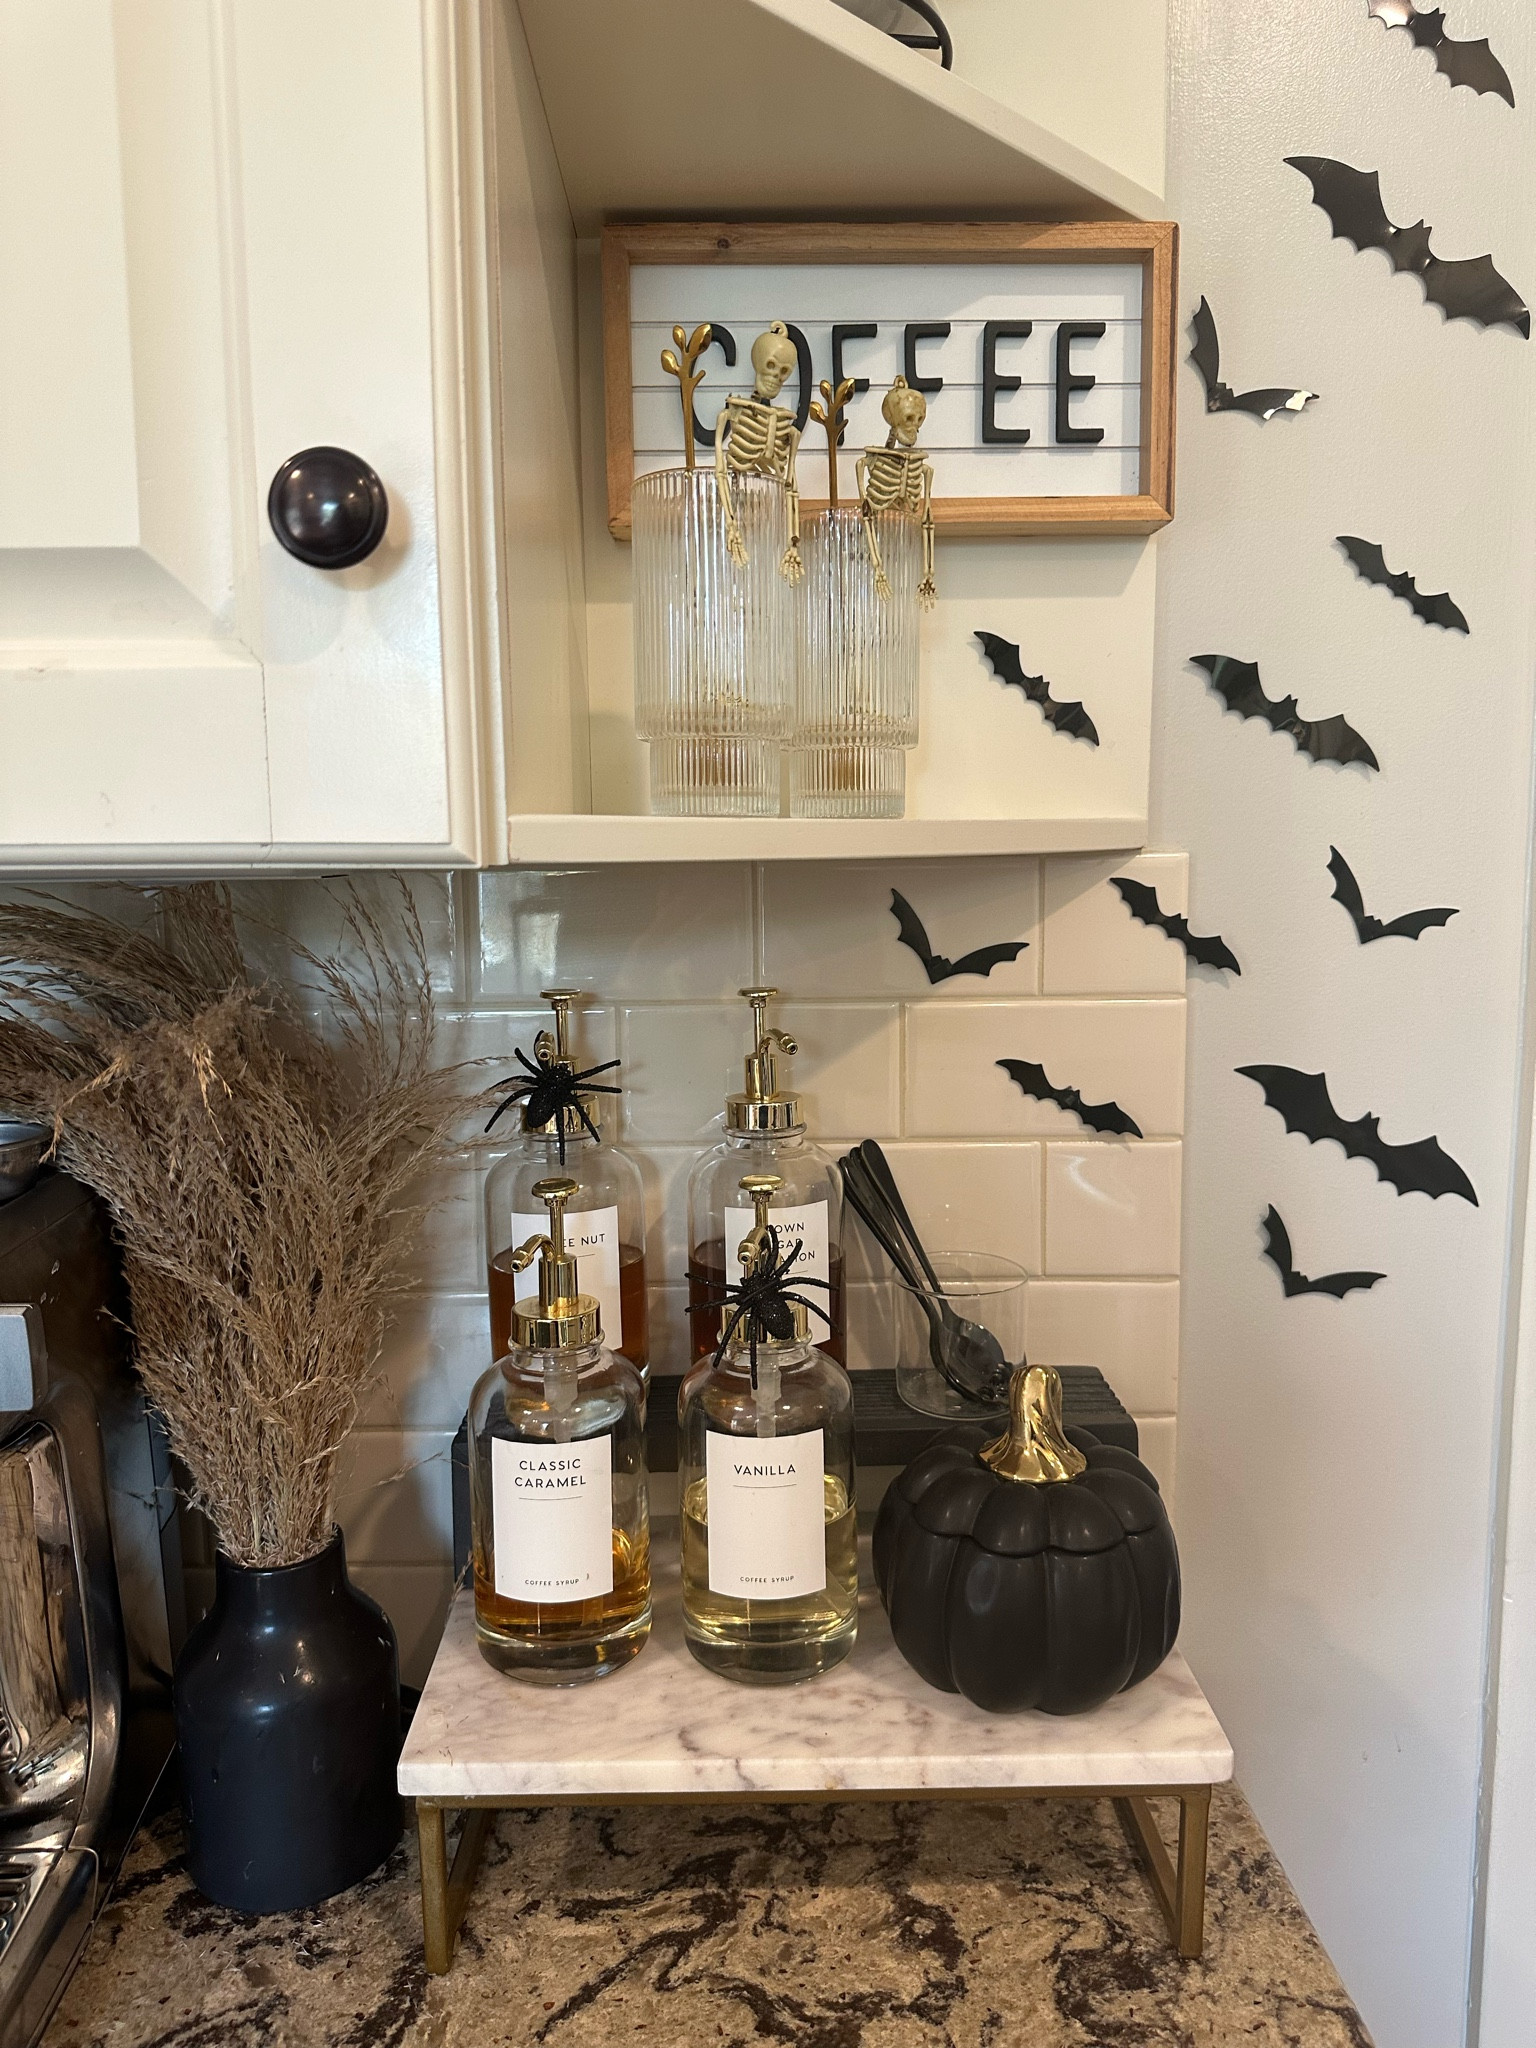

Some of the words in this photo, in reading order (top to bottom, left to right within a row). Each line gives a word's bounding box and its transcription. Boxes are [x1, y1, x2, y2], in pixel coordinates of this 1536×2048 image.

[581, 1233, 605, 1248] NUT
[519, 1458, 581, 1471] CLASSIC
[733, 1464, 796, 1476] VANILLA
[514, 1475, 586, 1488] CARAMEL
[556, 1578, 580, 1586] SYRUP
[771, 1575, 794, 1583] SYRUP
